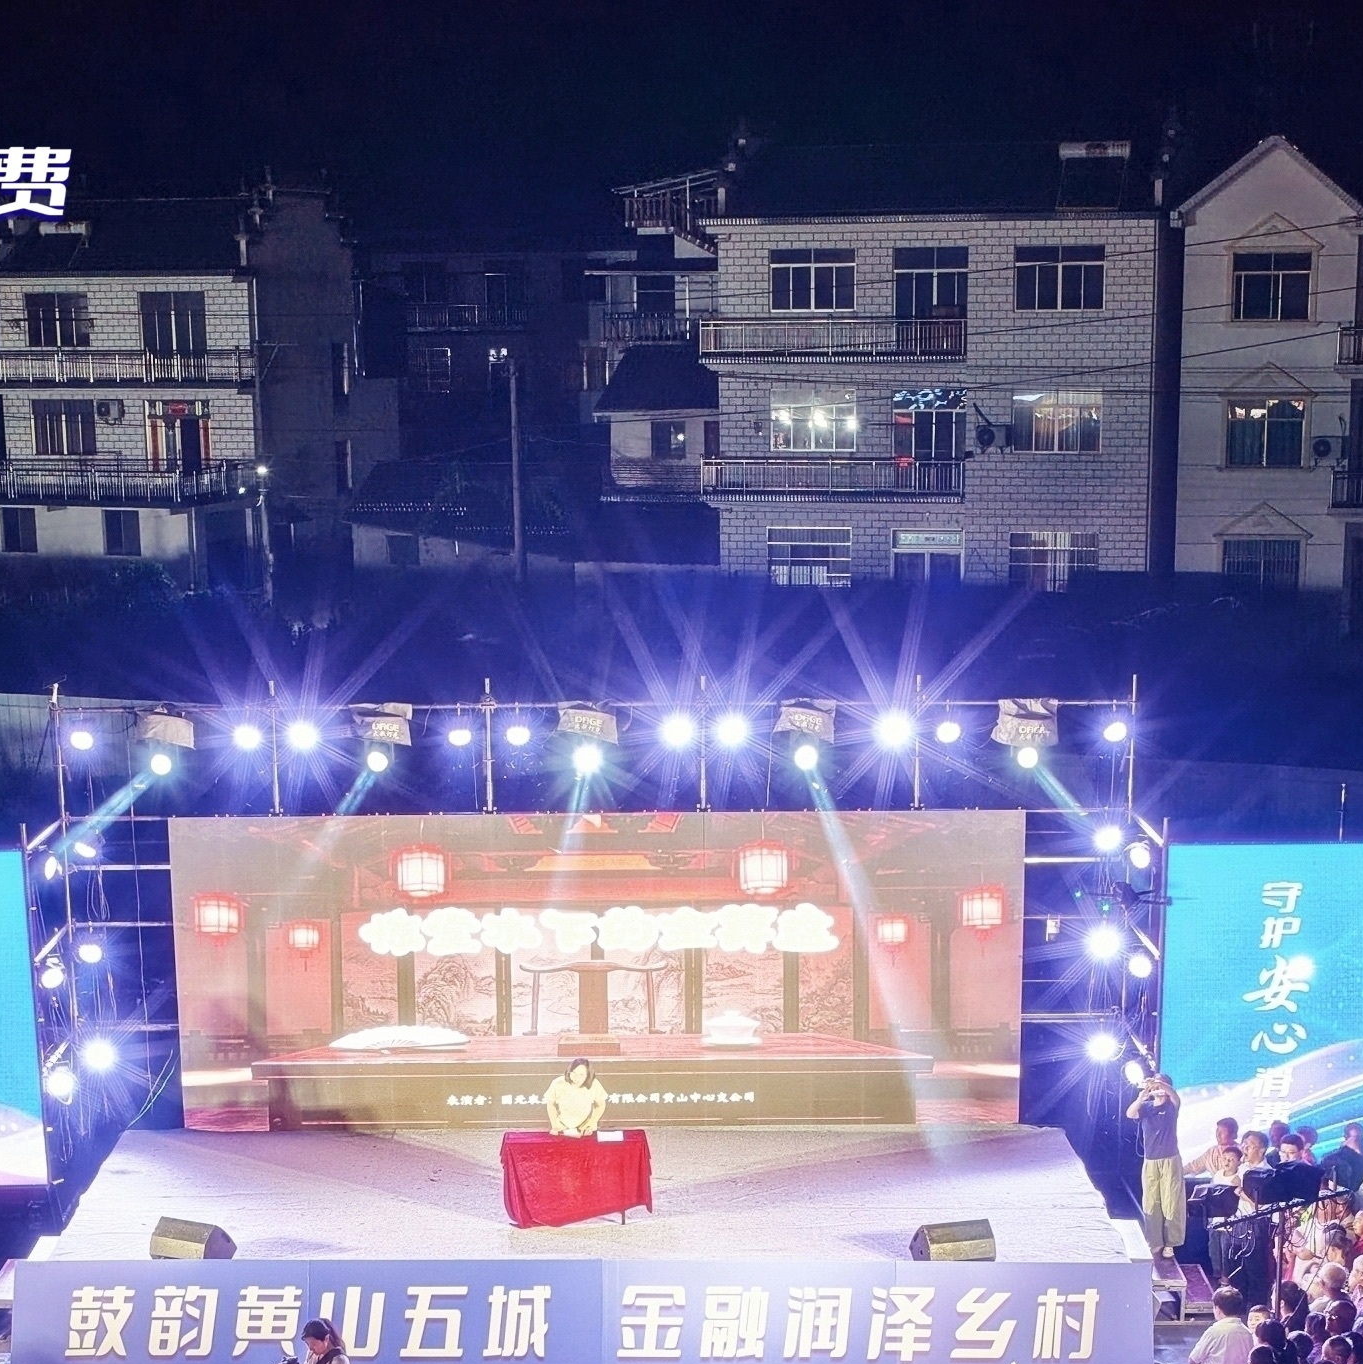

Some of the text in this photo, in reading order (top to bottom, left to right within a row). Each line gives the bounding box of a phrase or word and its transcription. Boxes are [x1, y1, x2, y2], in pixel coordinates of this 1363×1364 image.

[64, 1284, 1100, 1362] 鼓韵黄山五城 金融润泽乡村
